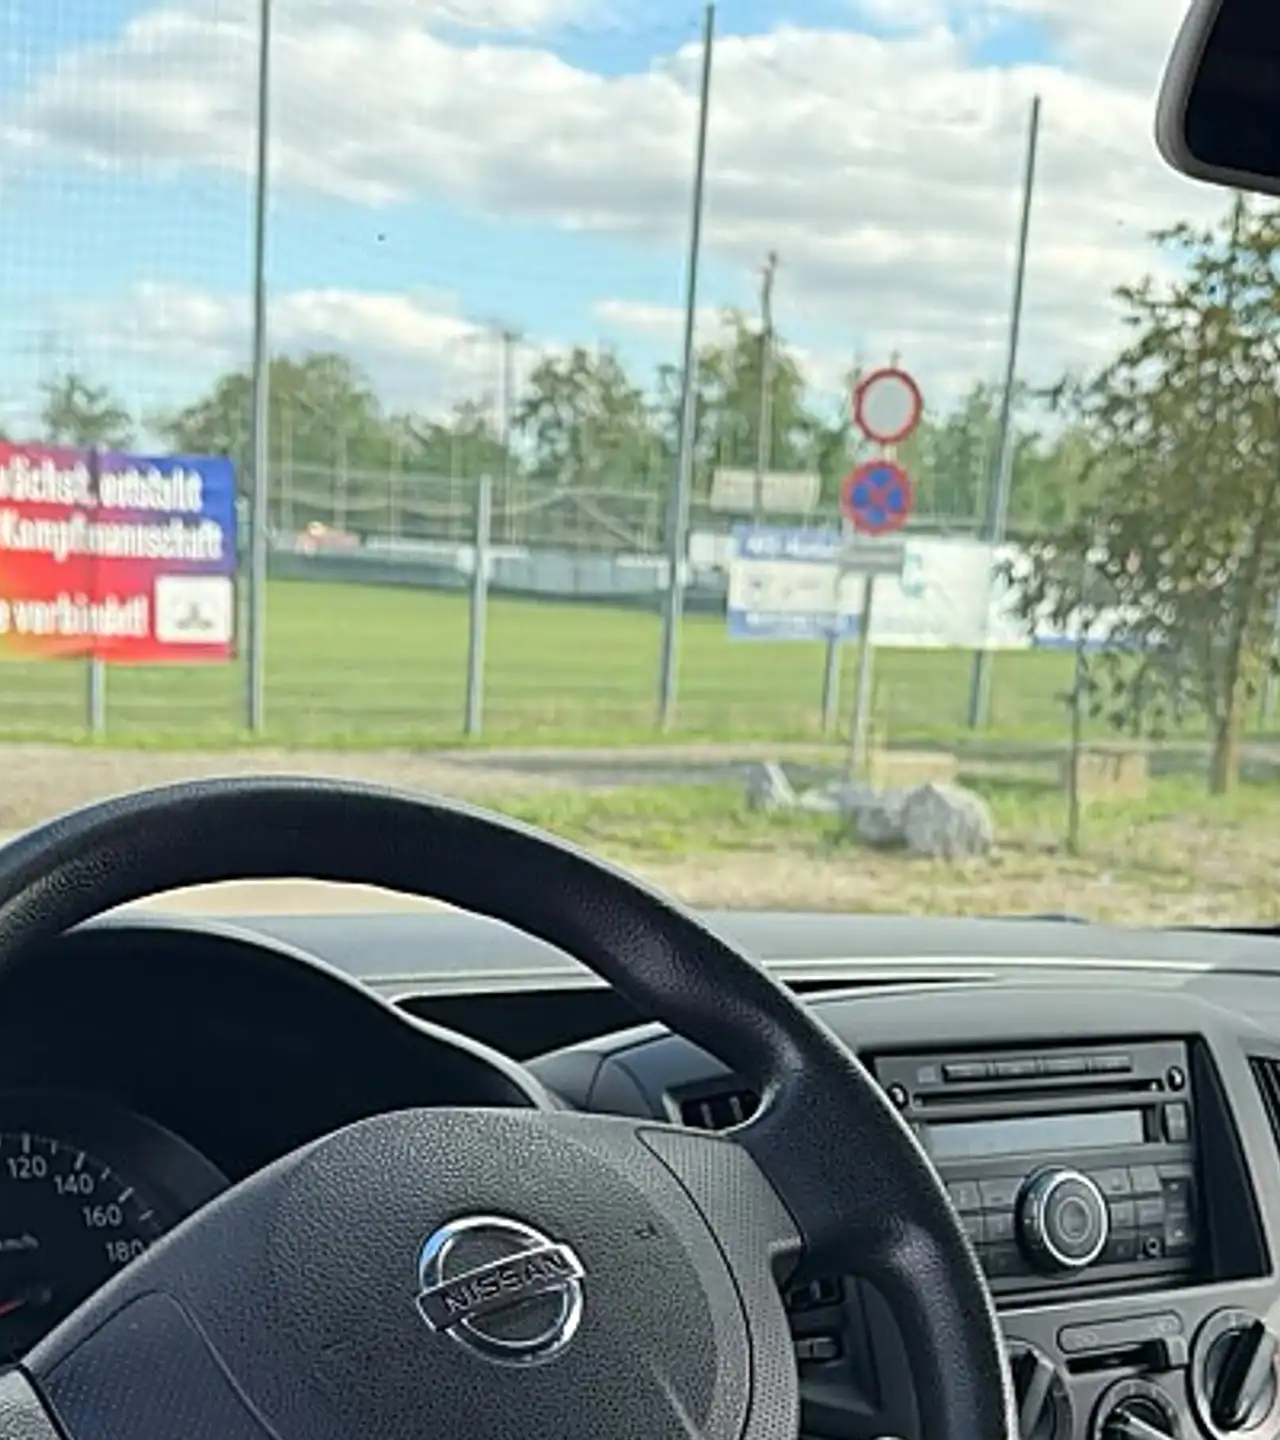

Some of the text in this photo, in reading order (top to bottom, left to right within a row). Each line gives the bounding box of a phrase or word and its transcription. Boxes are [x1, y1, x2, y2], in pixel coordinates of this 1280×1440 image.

[7, 1155, 47, 1179] 120
[54, 1173, 95, 1196] 140
[83, 1204, 122, 1228] 160
[106, 1240, 145, 1263] 180
[442, 1253, 570, 1317] NISSAN
